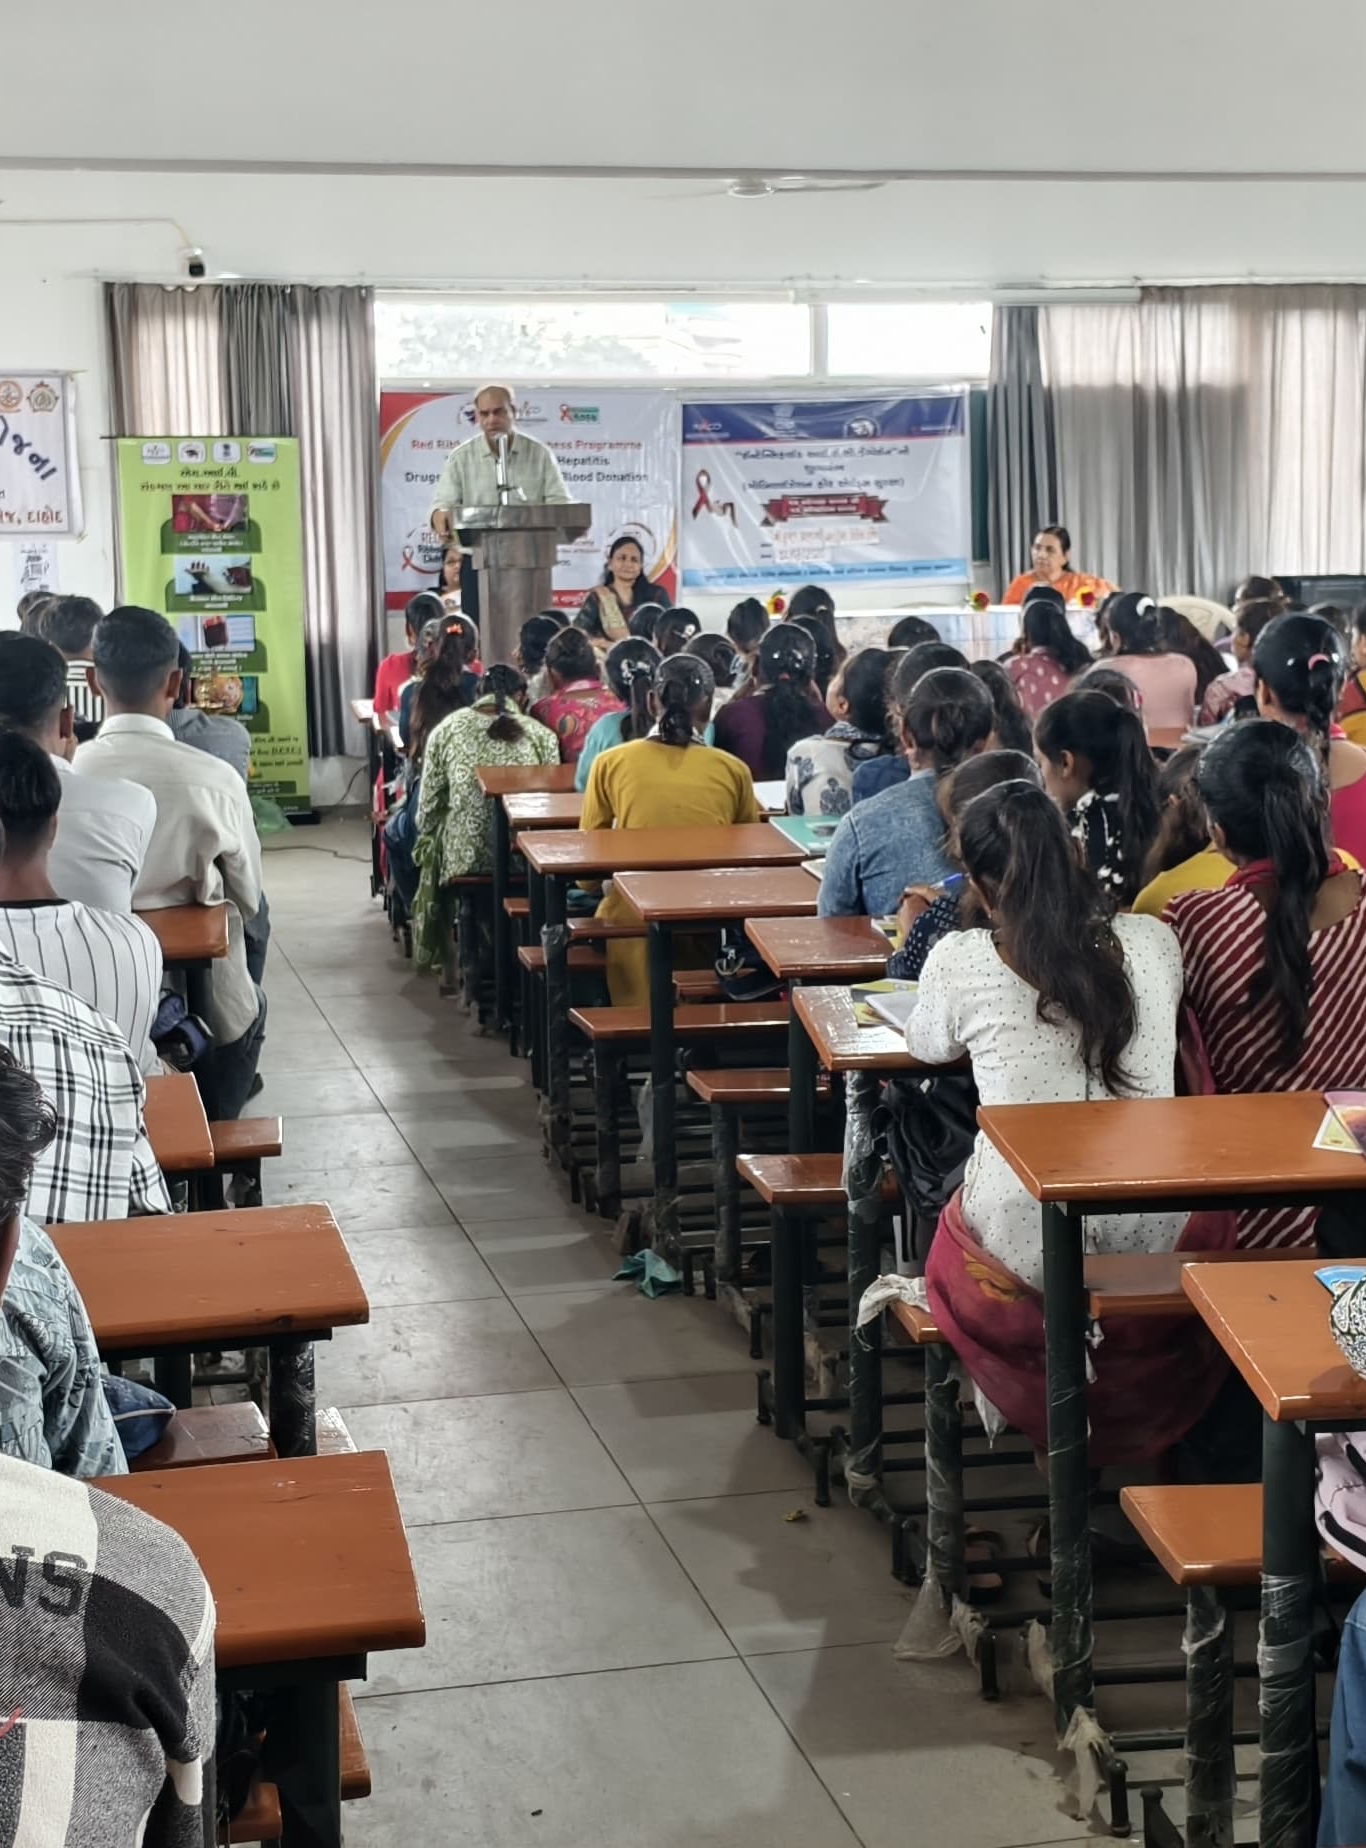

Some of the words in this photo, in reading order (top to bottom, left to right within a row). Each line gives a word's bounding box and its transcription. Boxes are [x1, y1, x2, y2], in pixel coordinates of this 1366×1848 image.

[410, 439, 434, 450] Red
[575, 439, 643, 453] Programme
[557, 455, 611, 468] Hepatitis
[596, 471, 649, 482] Donation
[26, 504, 64, 525] દાહોદ
